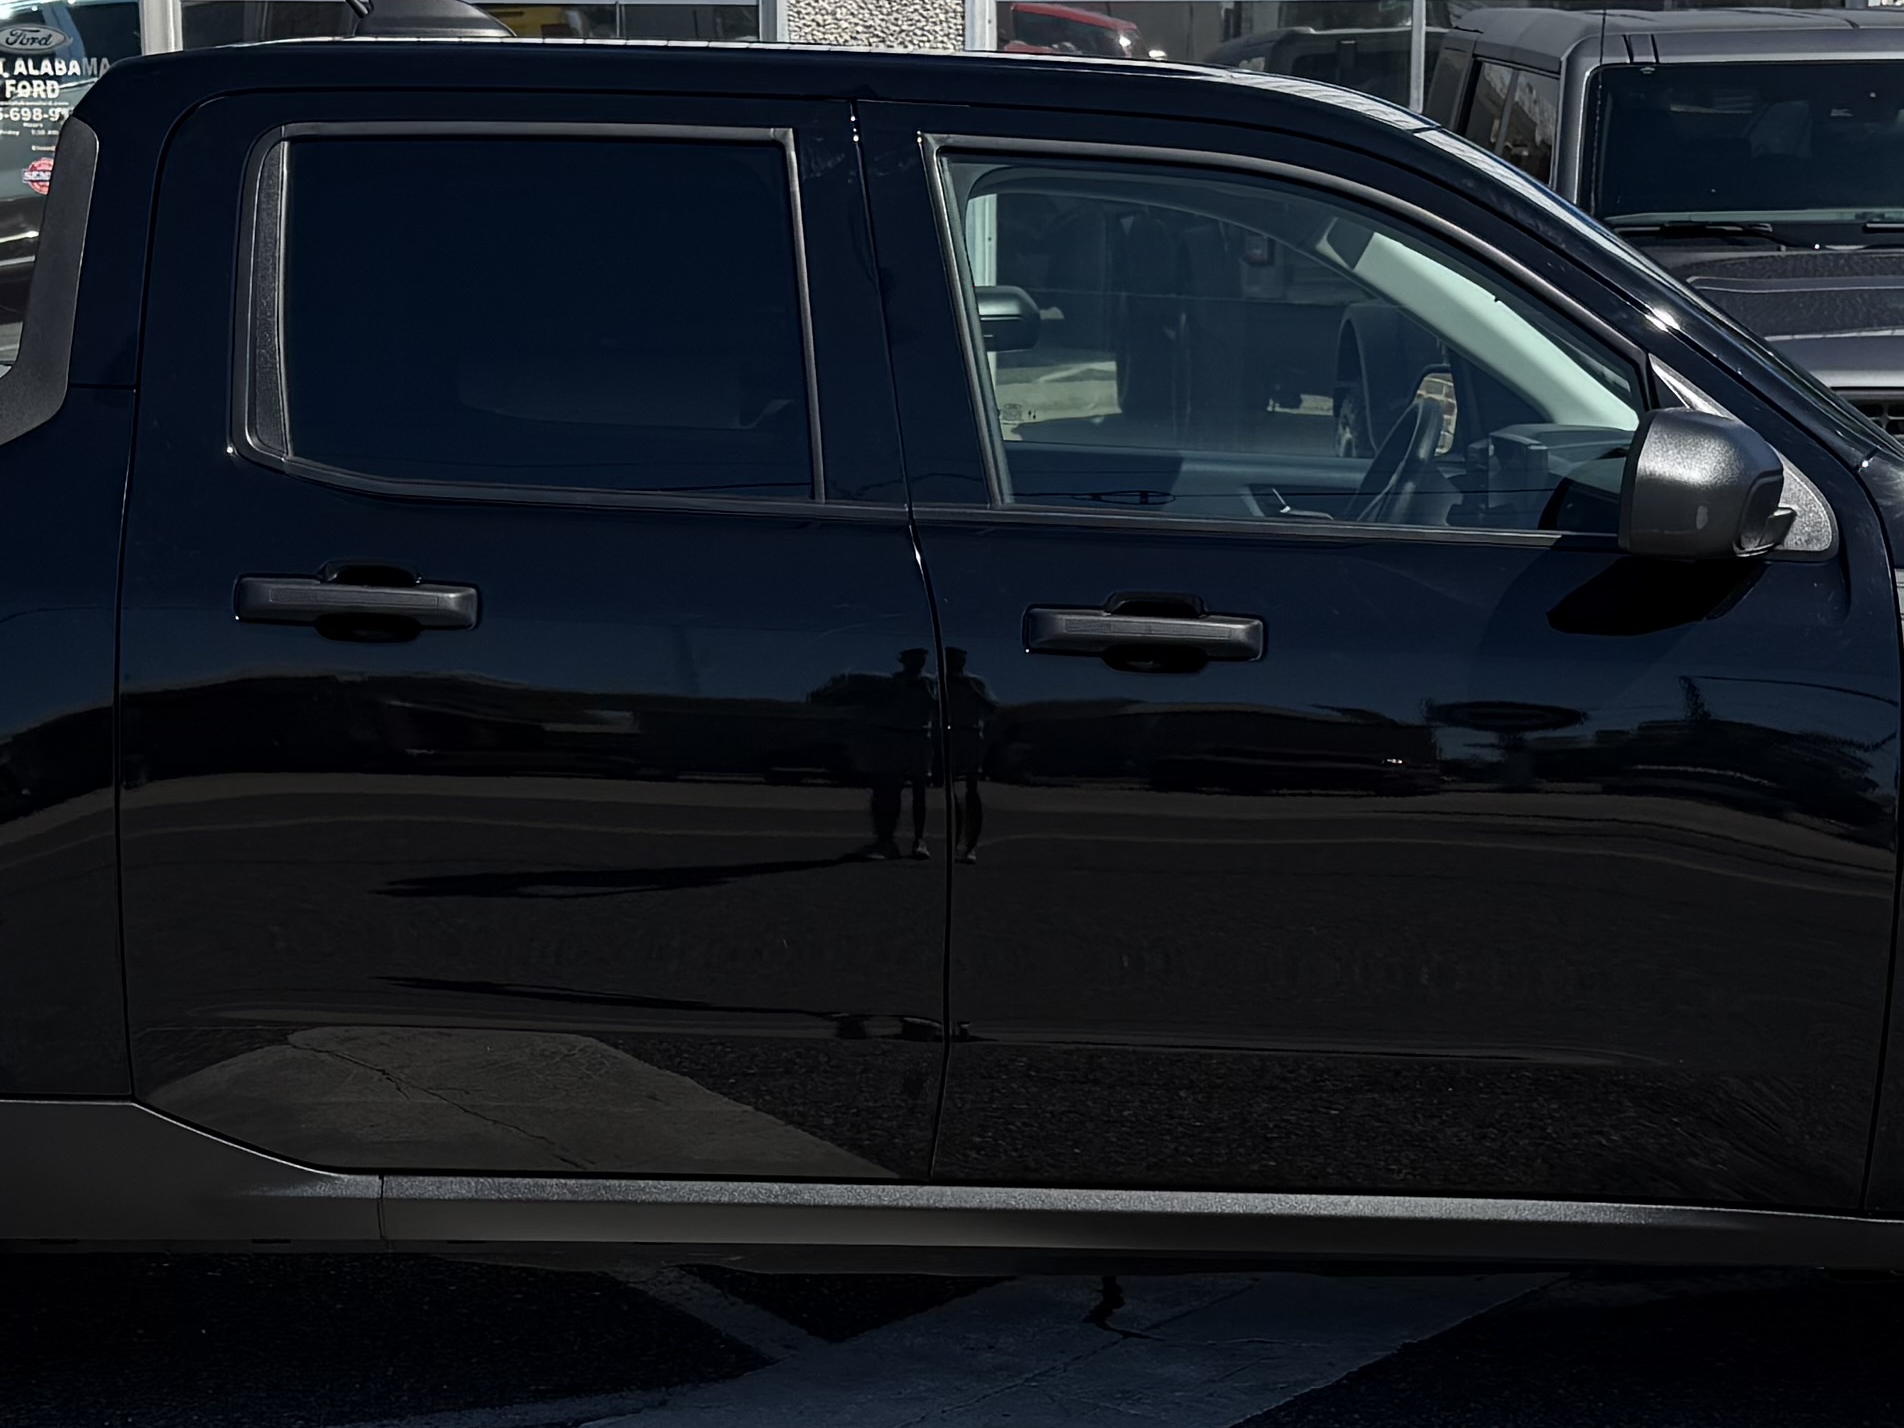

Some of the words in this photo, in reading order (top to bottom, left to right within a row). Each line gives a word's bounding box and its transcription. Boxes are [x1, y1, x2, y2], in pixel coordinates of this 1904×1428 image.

[5, 28, 53, 46] Ford
[13, 57, 110, 77] ALABAMA
[5, 79, 60, 99] FORD
